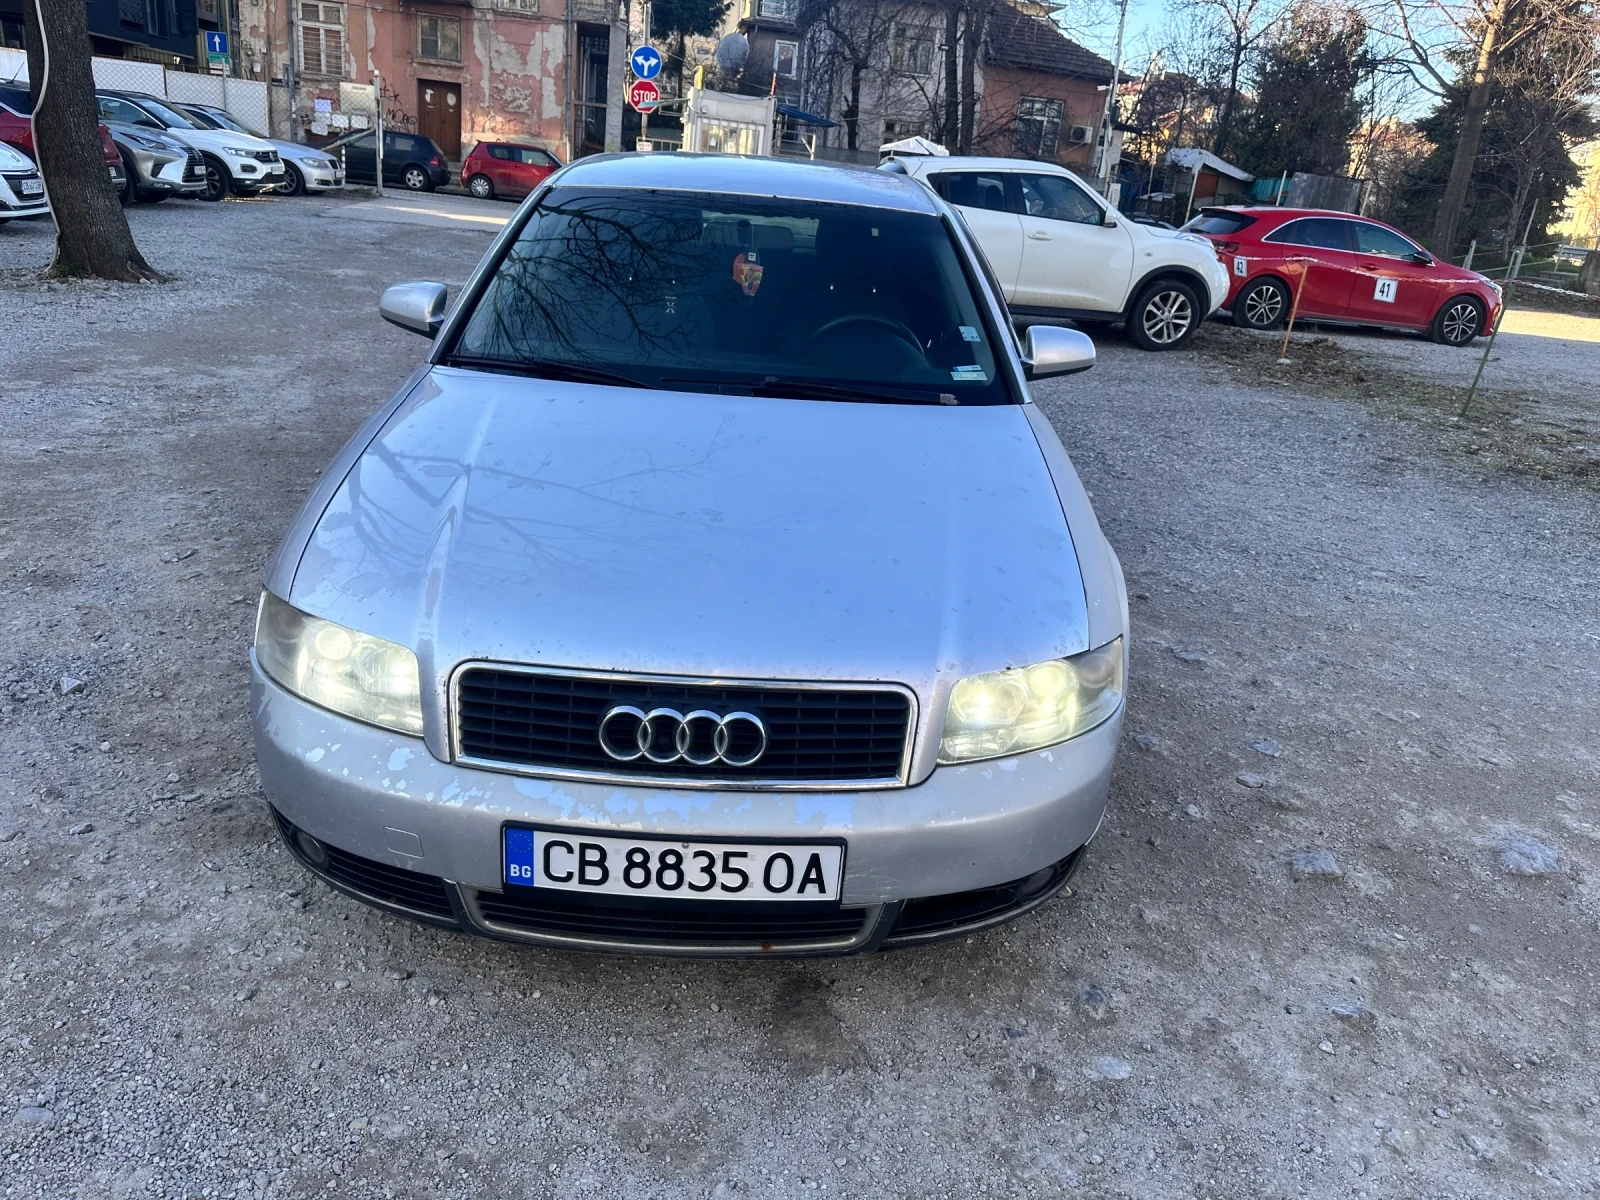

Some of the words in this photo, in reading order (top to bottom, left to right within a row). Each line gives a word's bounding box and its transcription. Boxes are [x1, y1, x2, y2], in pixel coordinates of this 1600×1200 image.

[633, 89, 657, 102] STOP
[1236, 261, 1244, 274] 42
[1379, 282, 1391, 298] 41
[510, 863, 531, 878] BG
[543, 840, 609, 886] CB
[623, 846, 750, 894] 8835
